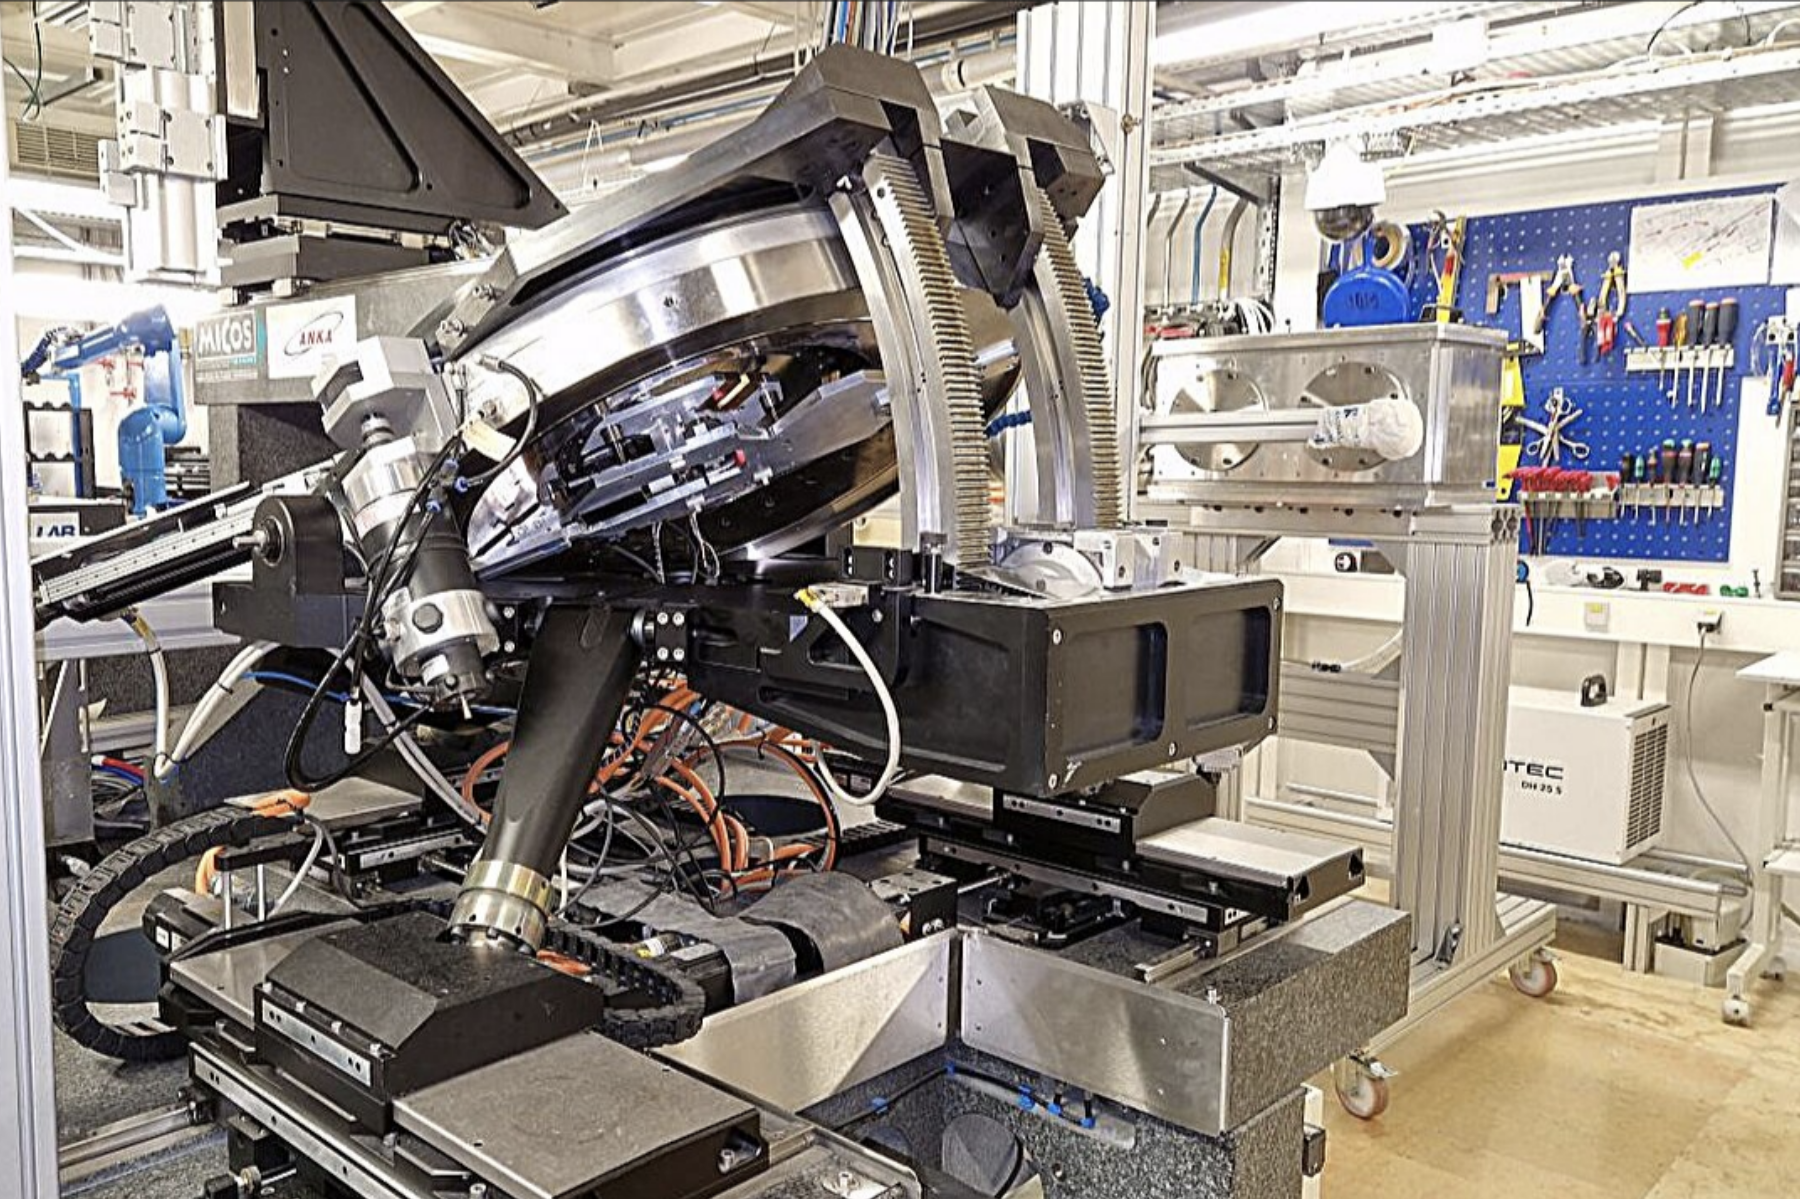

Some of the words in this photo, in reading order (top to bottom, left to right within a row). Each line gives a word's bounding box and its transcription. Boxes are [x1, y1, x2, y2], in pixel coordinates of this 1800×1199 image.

[198, 316, 252, 357] MICOS
[299, 329, 333, 346] ANKA
[1503, 759, 1564, 780] TEC
[1521, 781, 1537, 790] DH
